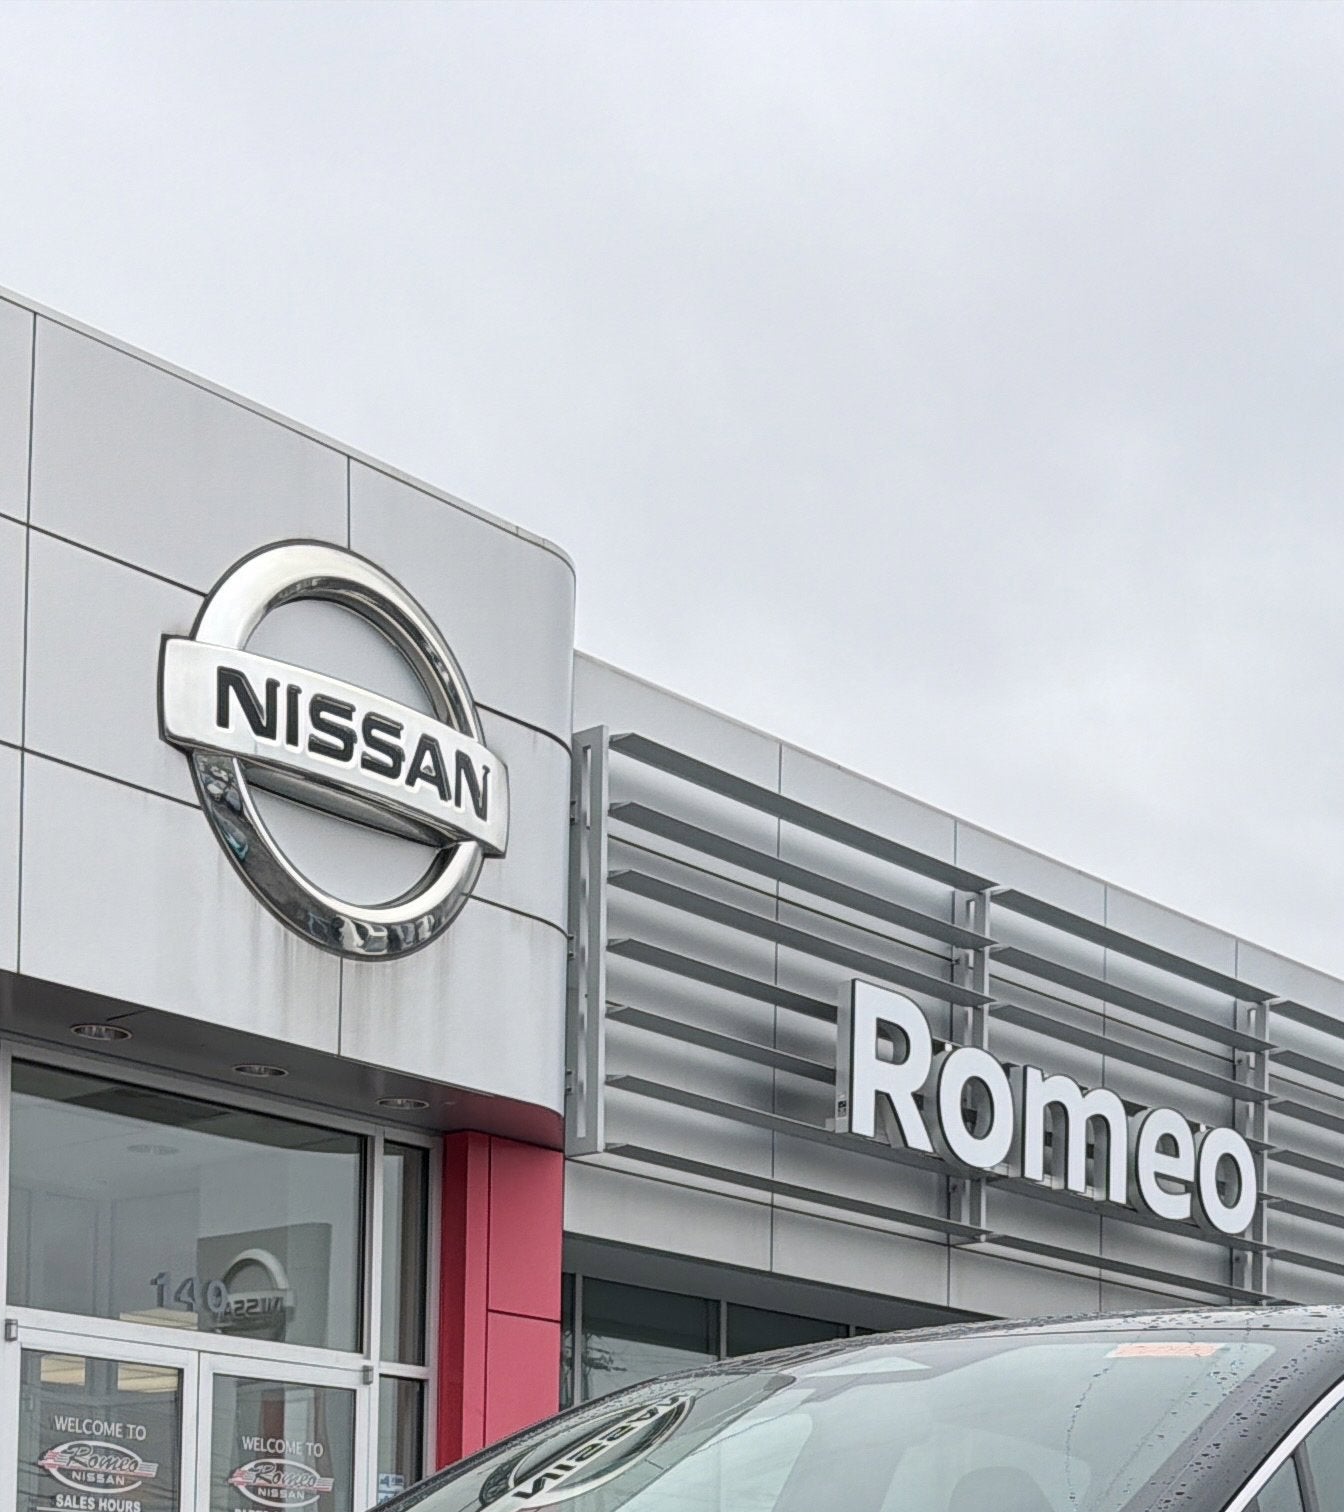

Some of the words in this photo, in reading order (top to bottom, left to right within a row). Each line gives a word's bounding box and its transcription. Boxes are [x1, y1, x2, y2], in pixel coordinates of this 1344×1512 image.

[216, 665, 491, 822] NISSAN
[849, 977, 1257, 1235] Romeo
[150, 1272, 228, 1313] 140
[55, 1415, 123, 1438] WELCOME
[126, 1424, 147, 1441] TO
[61, 1443, 140, 1472] Romeo
[242, 1435, 303, 1456] WELCOME
[306, 1442, 324, 1458] TO
[71, 1471, 125, 1486] NISSAN
[252, 1462, 317, 1489] Romeo
[56, 1494, 95, 1510] SALES
[257, 1488, 305, 1500] NISSAN
